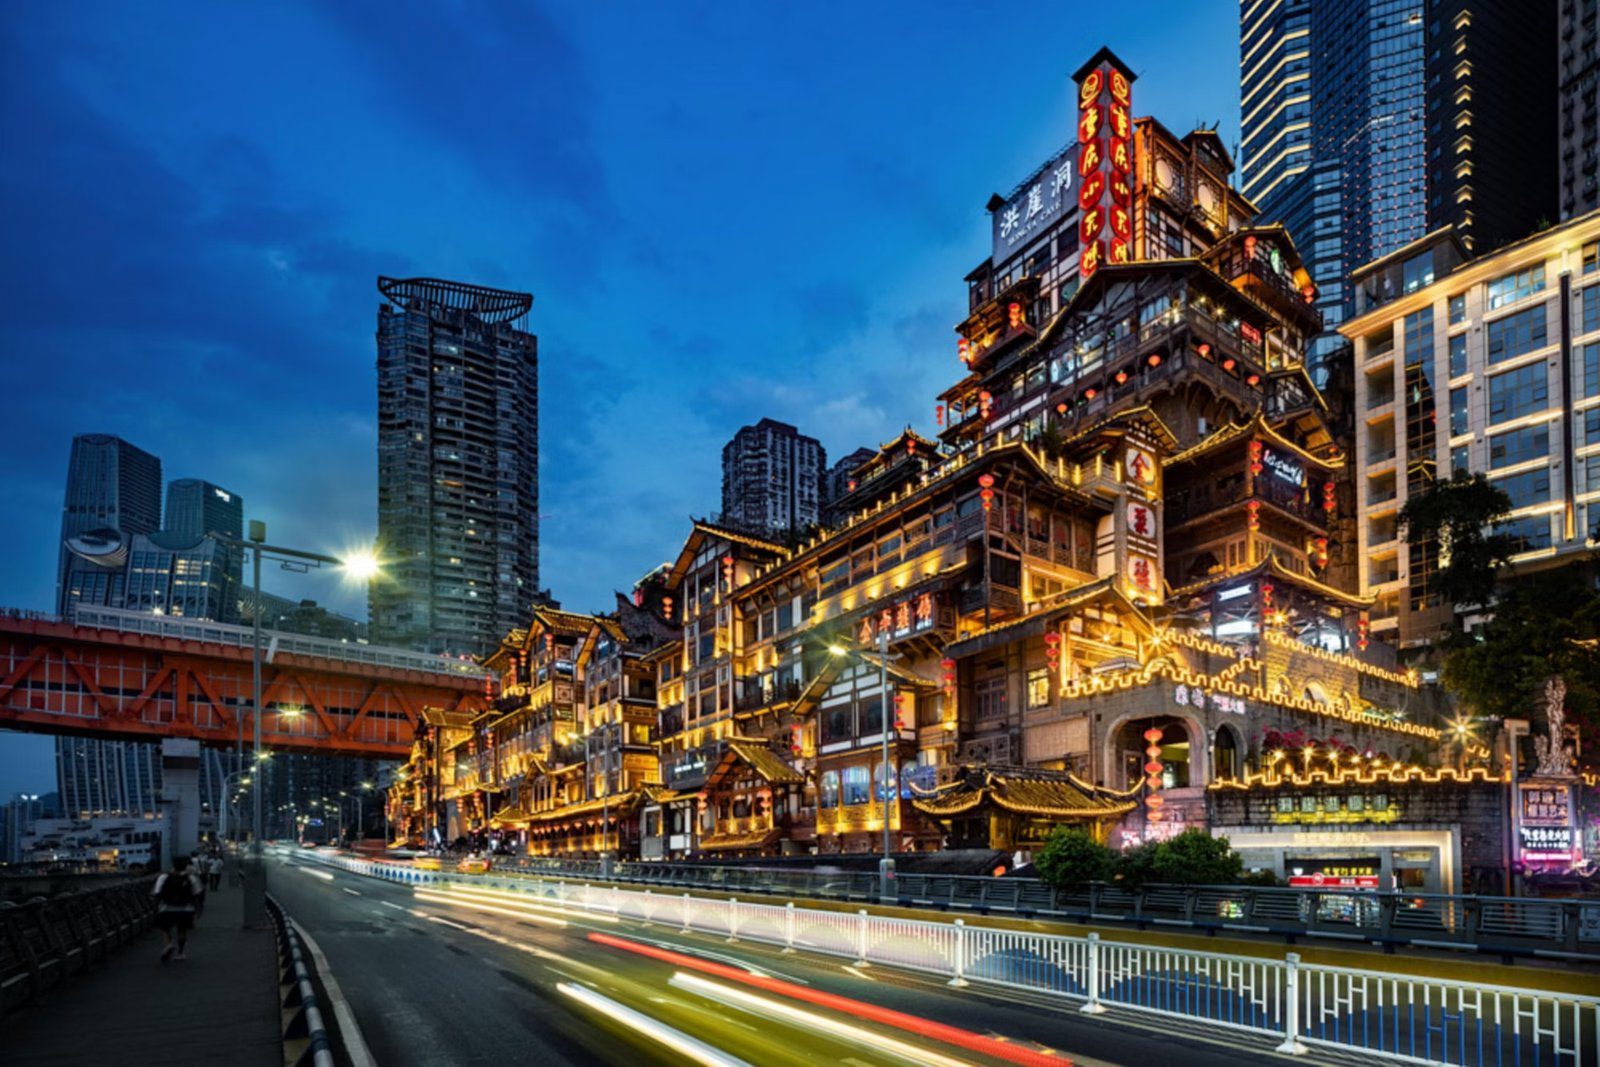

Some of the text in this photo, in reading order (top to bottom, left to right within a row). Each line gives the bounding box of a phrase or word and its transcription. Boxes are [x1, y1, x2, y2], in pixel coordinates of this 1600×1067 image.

[1000, 160, 1072, 238] 洪崖洞
[1080, 107, 1102, 270] 重庆小天鹅
